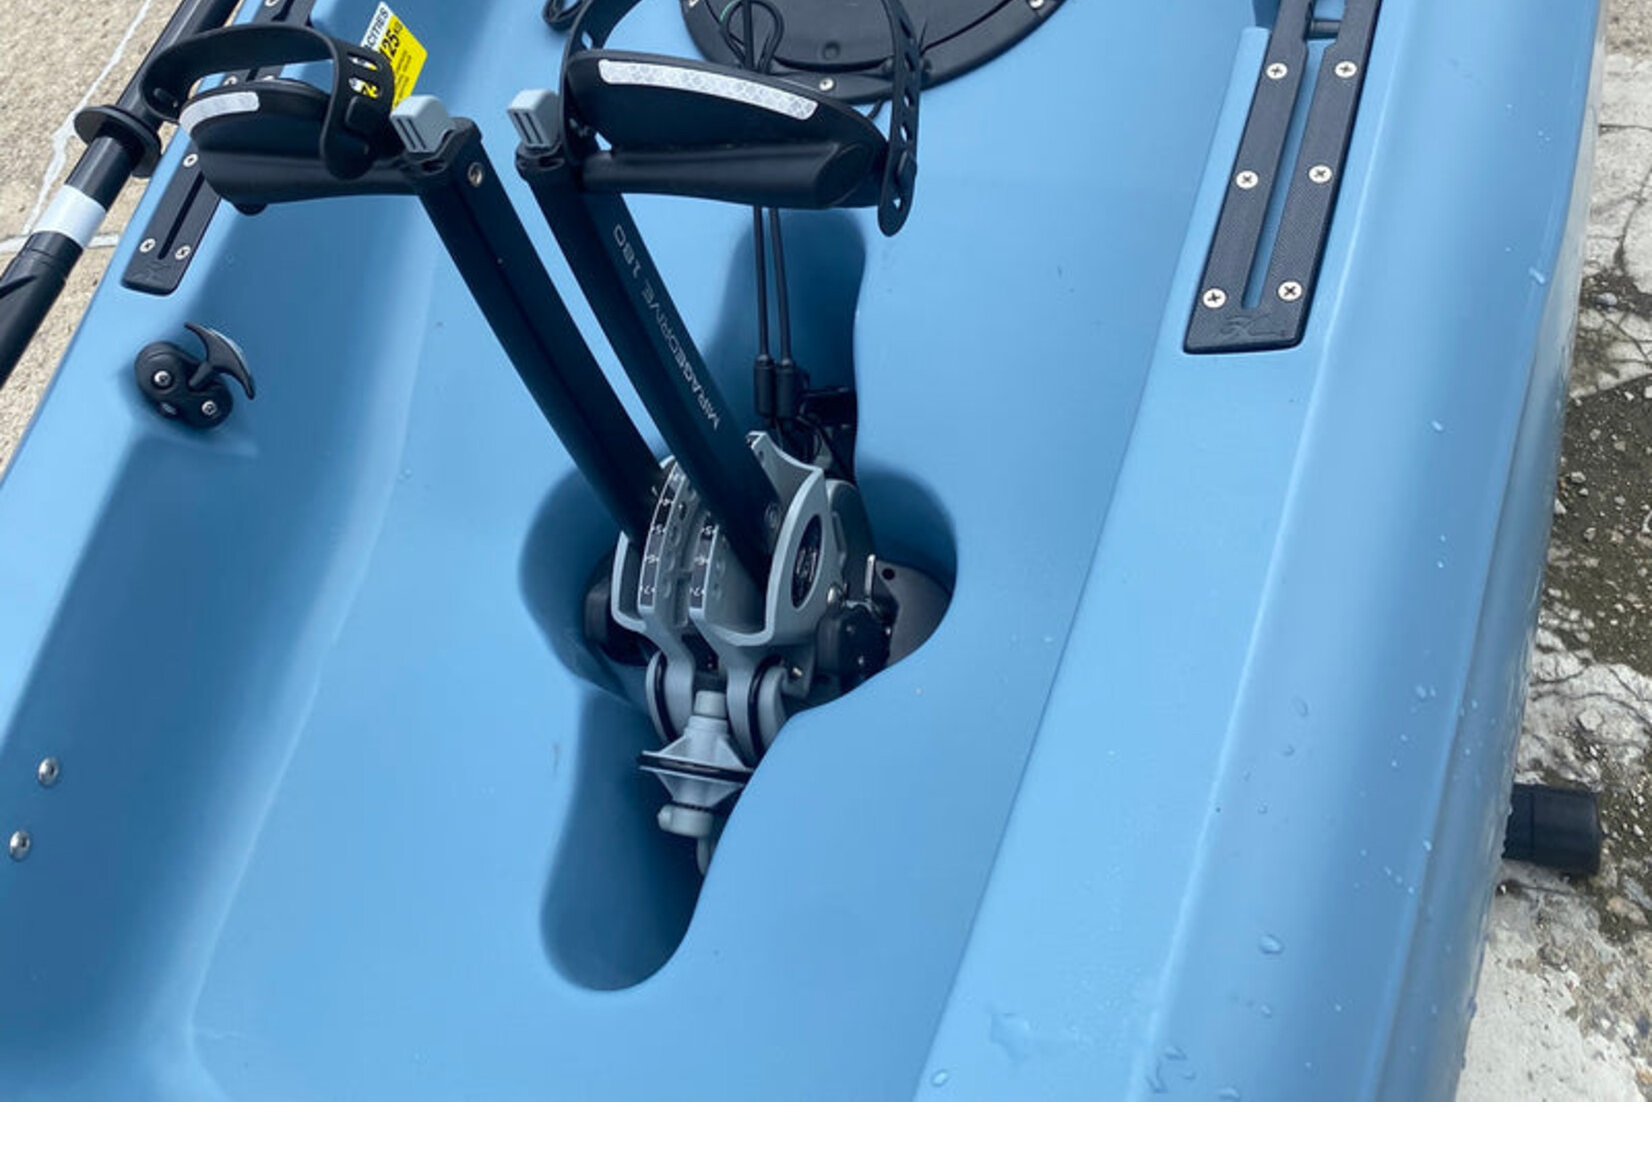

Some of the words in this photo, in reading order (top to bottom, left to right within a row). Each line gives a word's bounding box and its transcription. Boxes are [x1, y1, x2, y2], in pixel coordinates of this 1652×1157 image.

[365, 7, 389, 48] CITIES
[613, 223, 641, 278] 180
[641, 278, 720, 431] MIRAGEDRIVE
